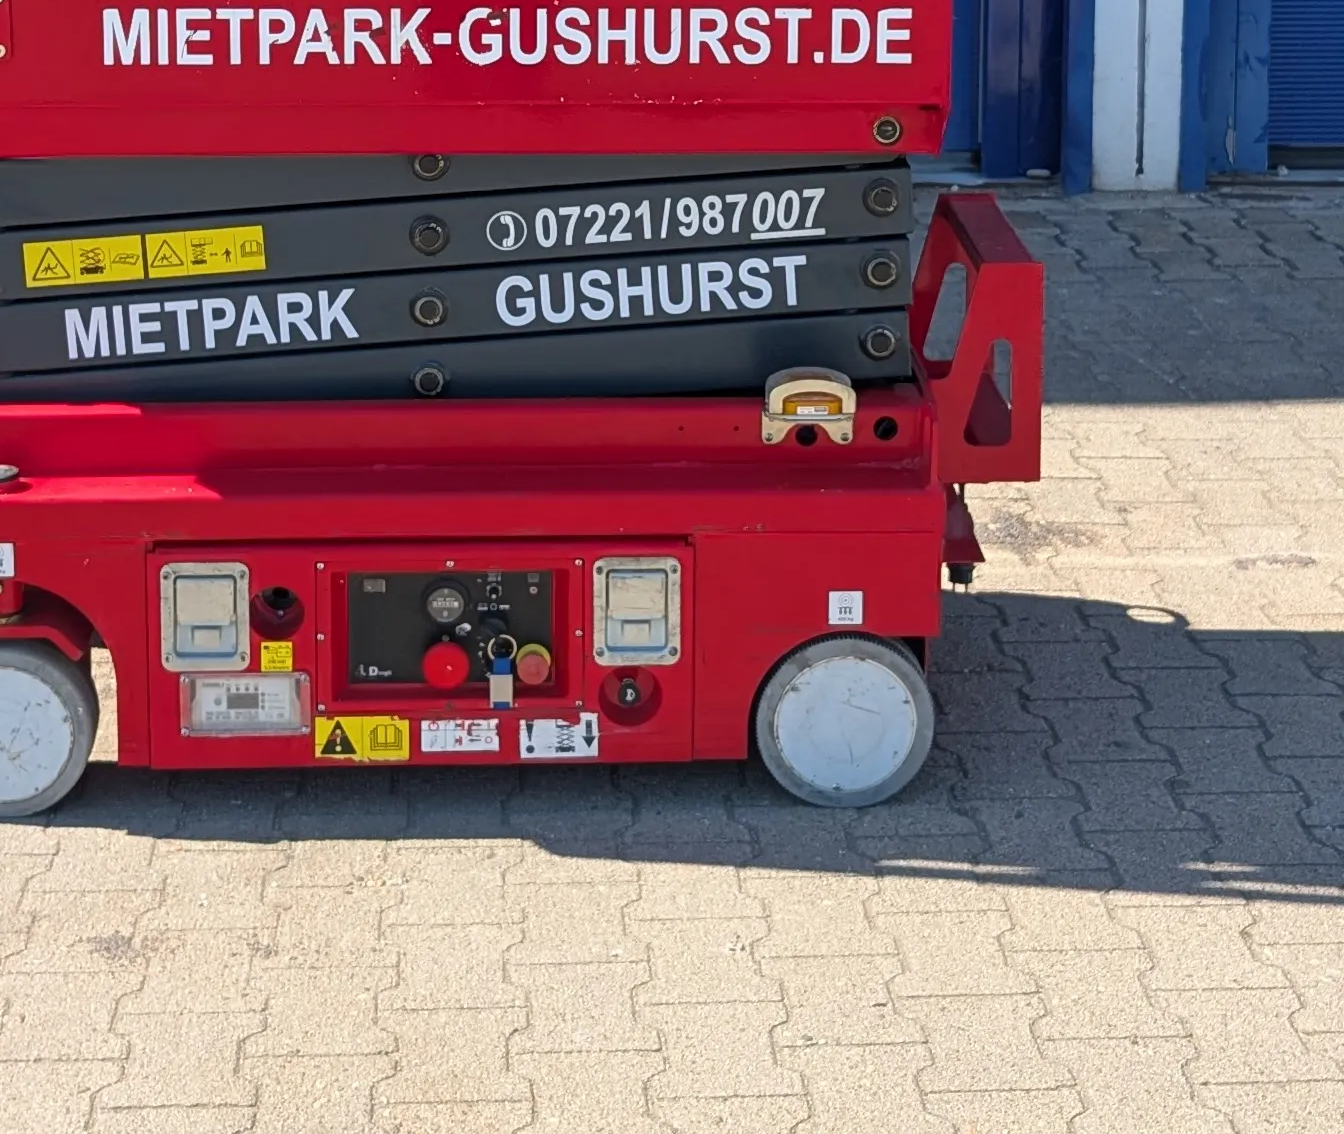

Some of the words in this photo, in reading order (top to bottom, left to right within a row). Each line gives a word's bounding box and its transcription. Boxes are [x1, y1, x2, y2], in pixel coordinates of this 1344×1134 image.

[102, 7, 913, 67] MIETPARK-GUSHURST.DE
[534, 187, 827, 248] 07221/987007
[495, 254, 807, 327] GUSHURST
[64, 288, 360, 360] MIETPARK
